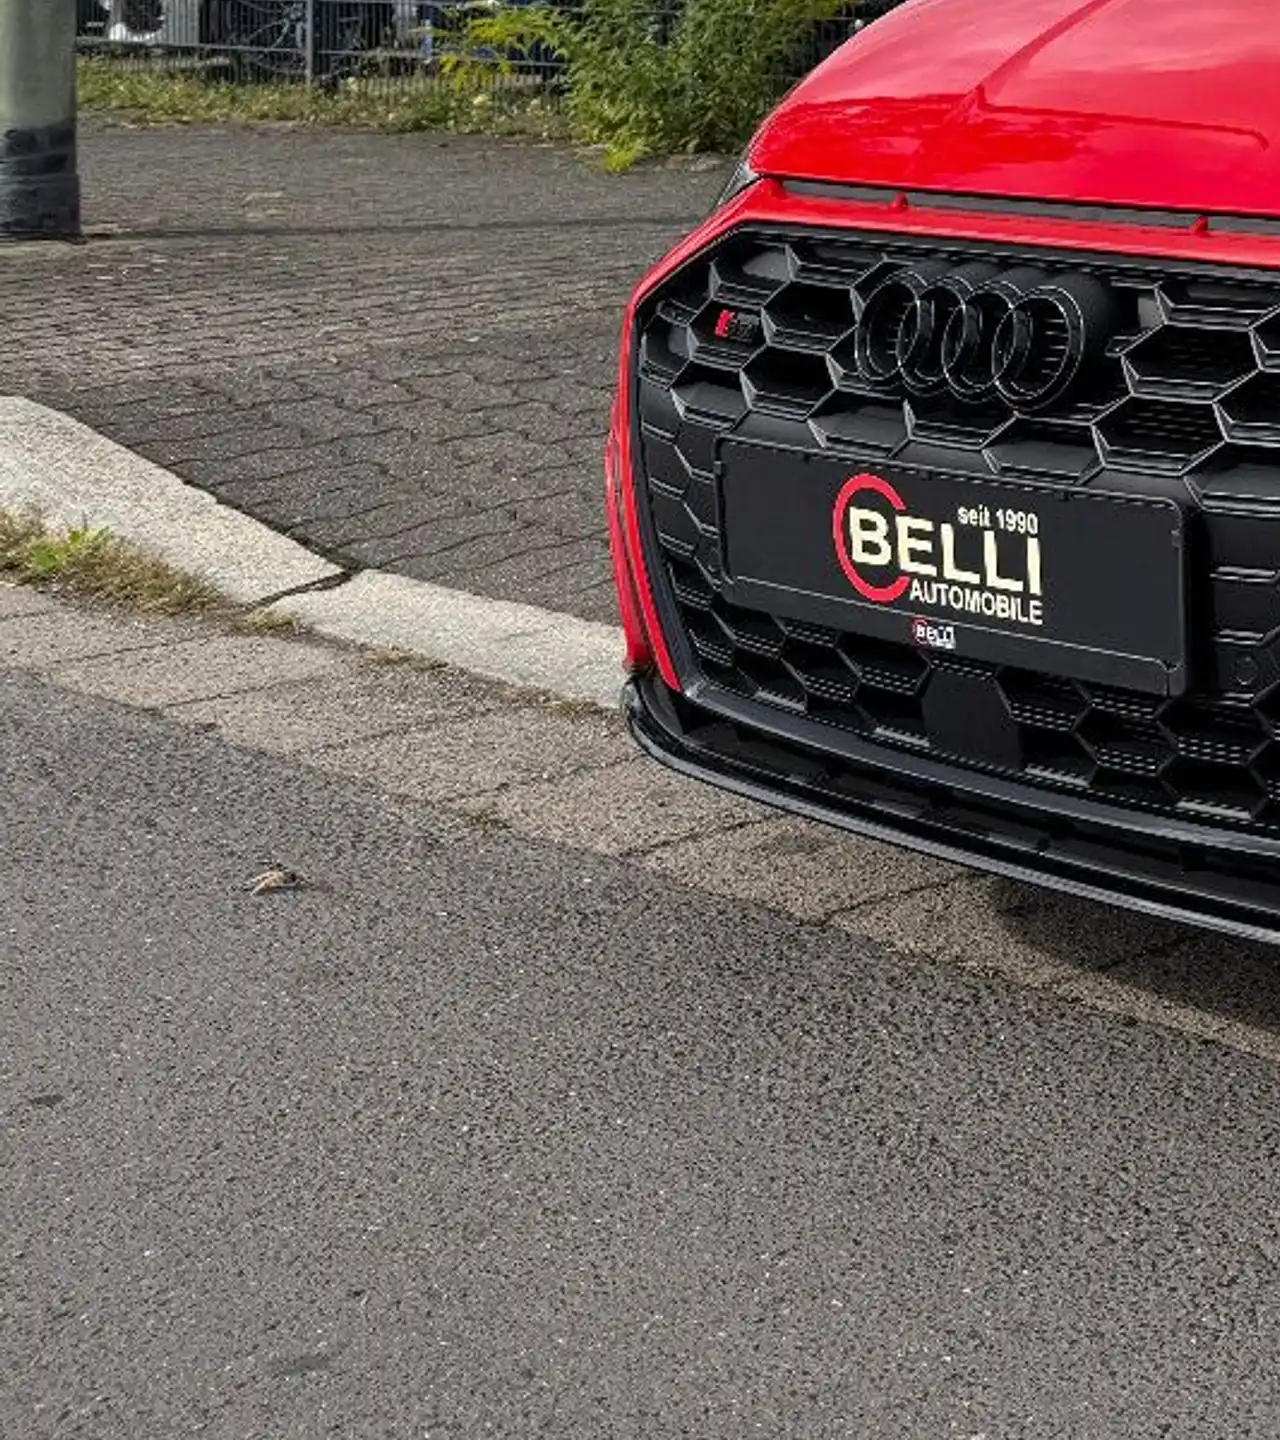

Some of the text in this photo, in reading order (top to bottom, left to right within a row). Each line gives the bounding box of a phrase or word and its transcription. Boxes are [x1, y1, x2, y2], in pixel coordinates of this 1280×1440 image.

[957, 504, 1039, 536] seit 1990
[849, 505, 1043, 597] BELLI
[909, 578, 1044, 626] AUTOMOBILE
